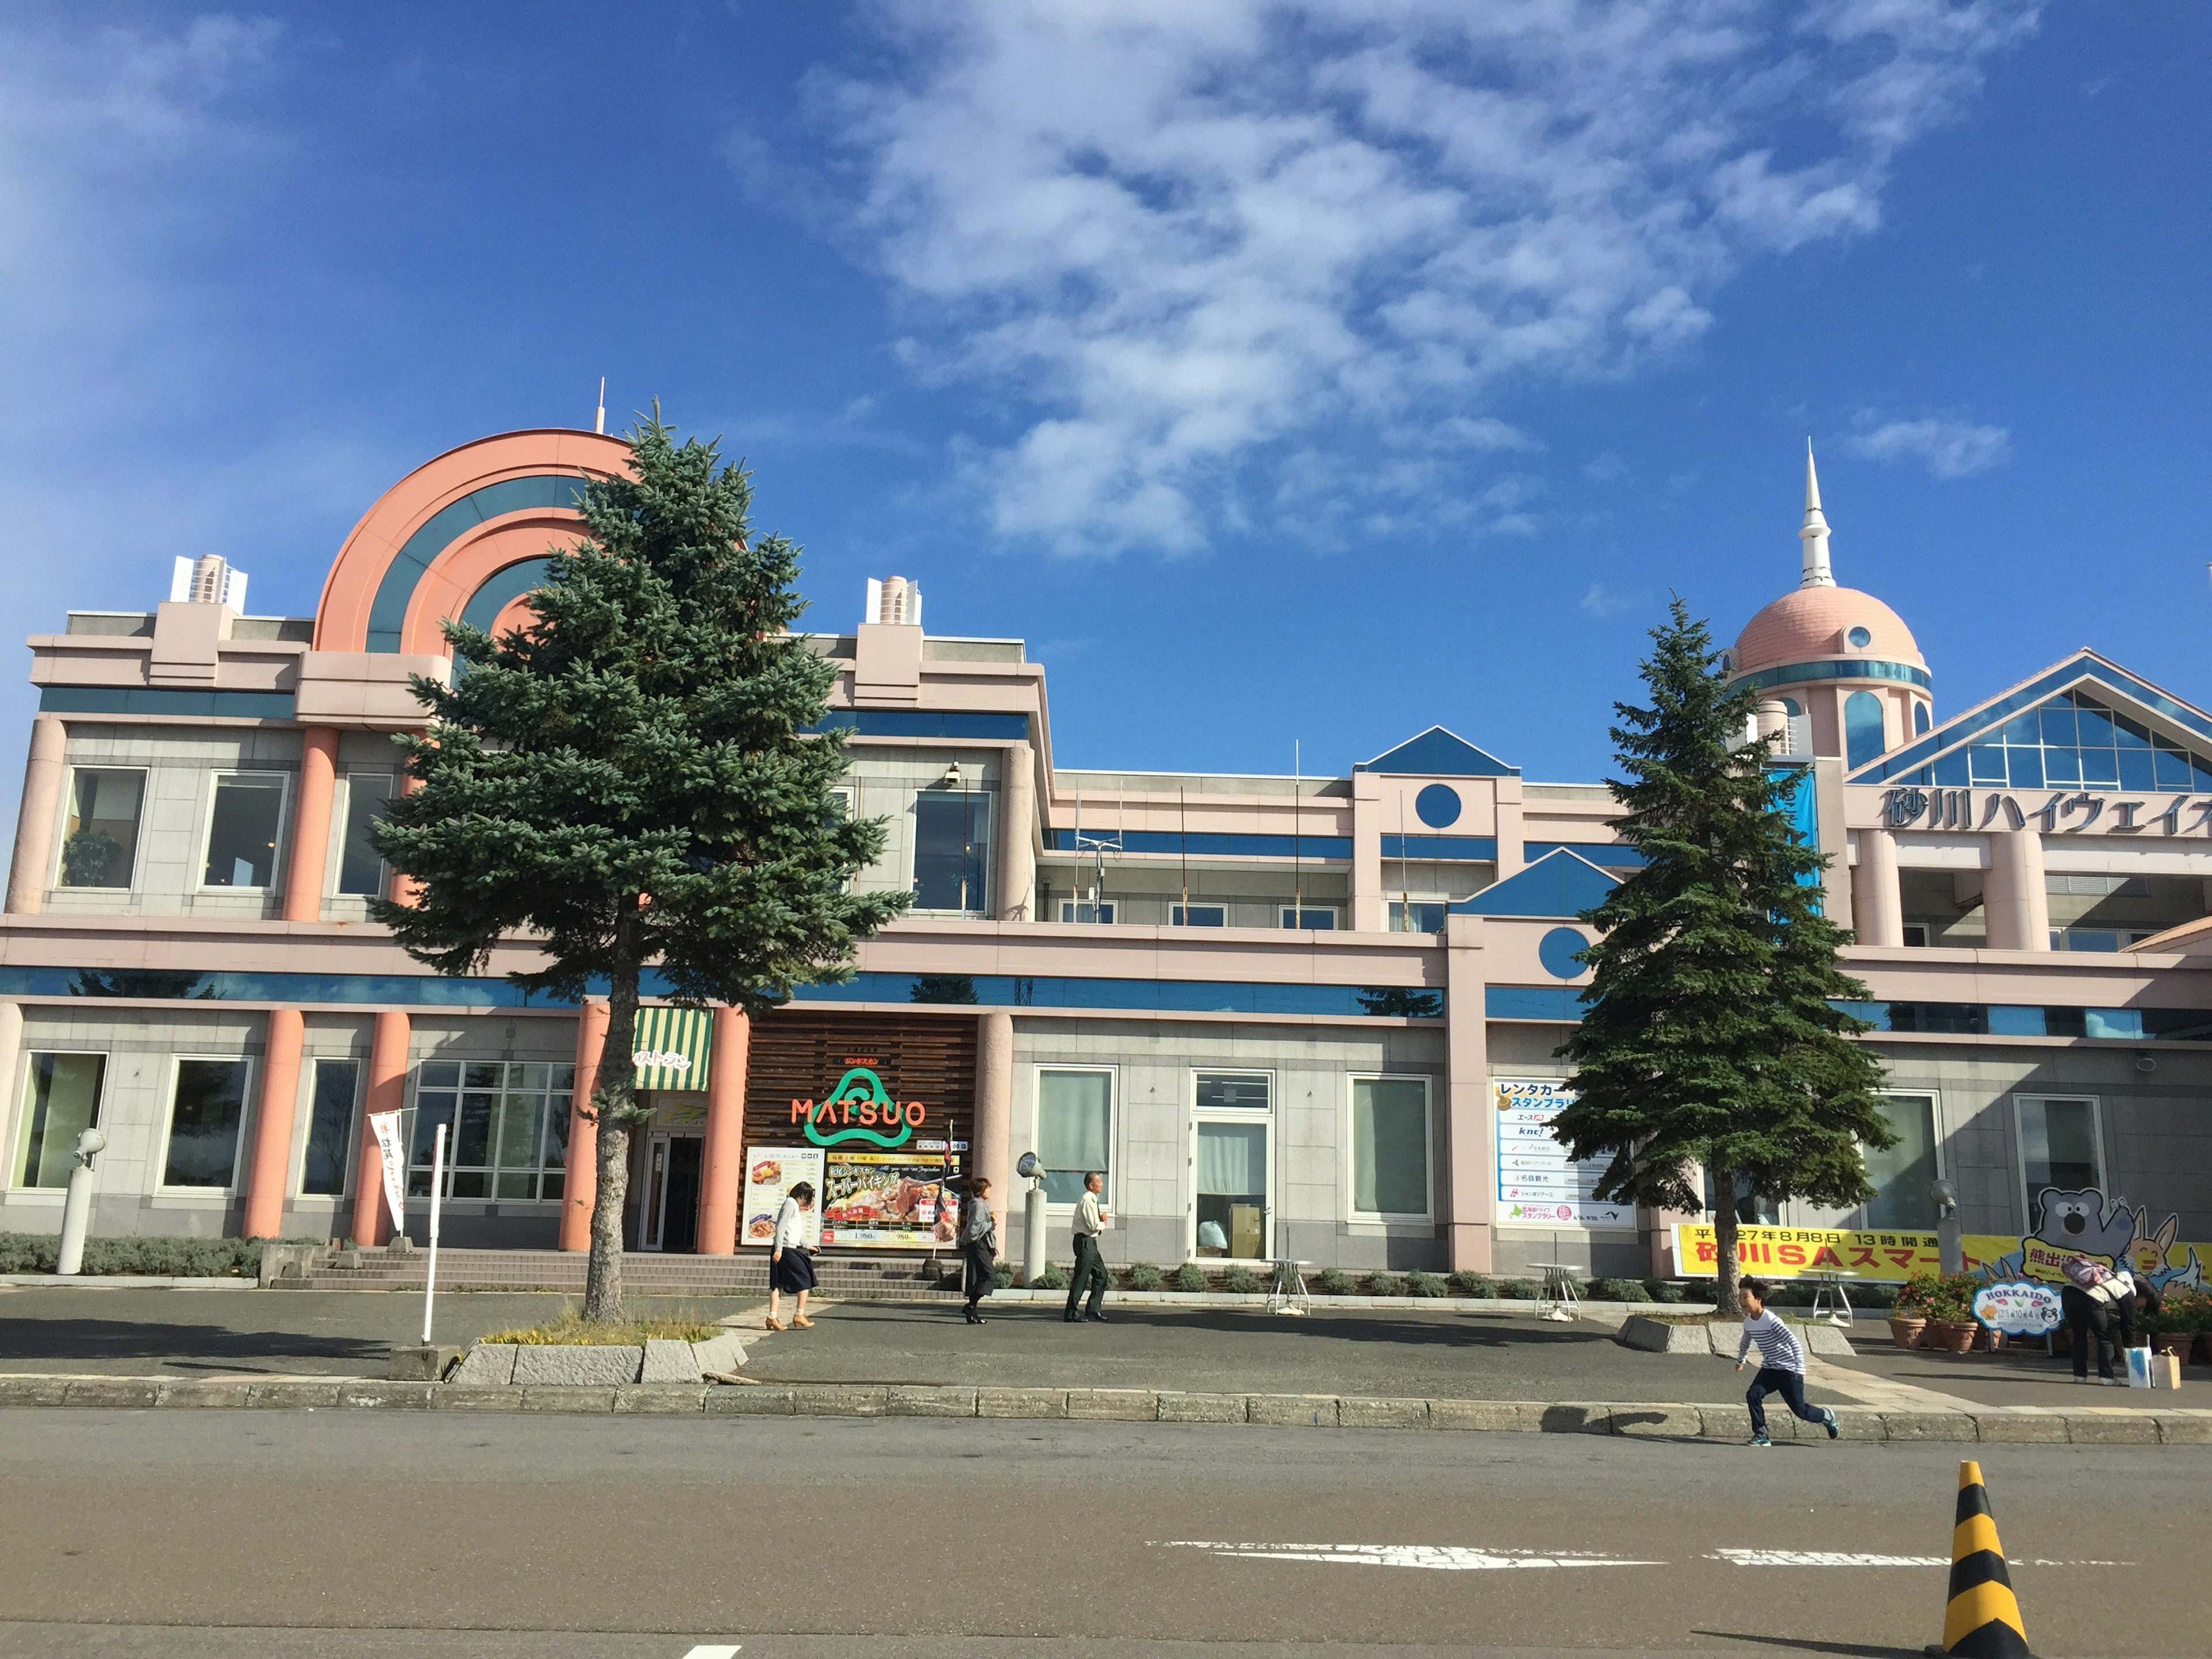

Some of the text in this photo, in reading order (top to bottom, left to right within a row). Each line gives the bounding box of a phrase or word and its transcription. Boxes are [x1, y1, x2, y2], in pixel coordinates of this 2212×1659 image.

[632, 1050, 692, 1070] ストラン
[1501, 1084, 1566, 1095] レンタカー
[1512, 1097, 1575, 1108] スタンプラリ
[791, 1099, 926, 1126] MATSUO
[825, 1172, 900, 1199] スーパーバイキング
[1695, 1229, 1841, 1244] 平27年8月8日
[1986, 1289, 2051, 1304] HOKKAIDO
